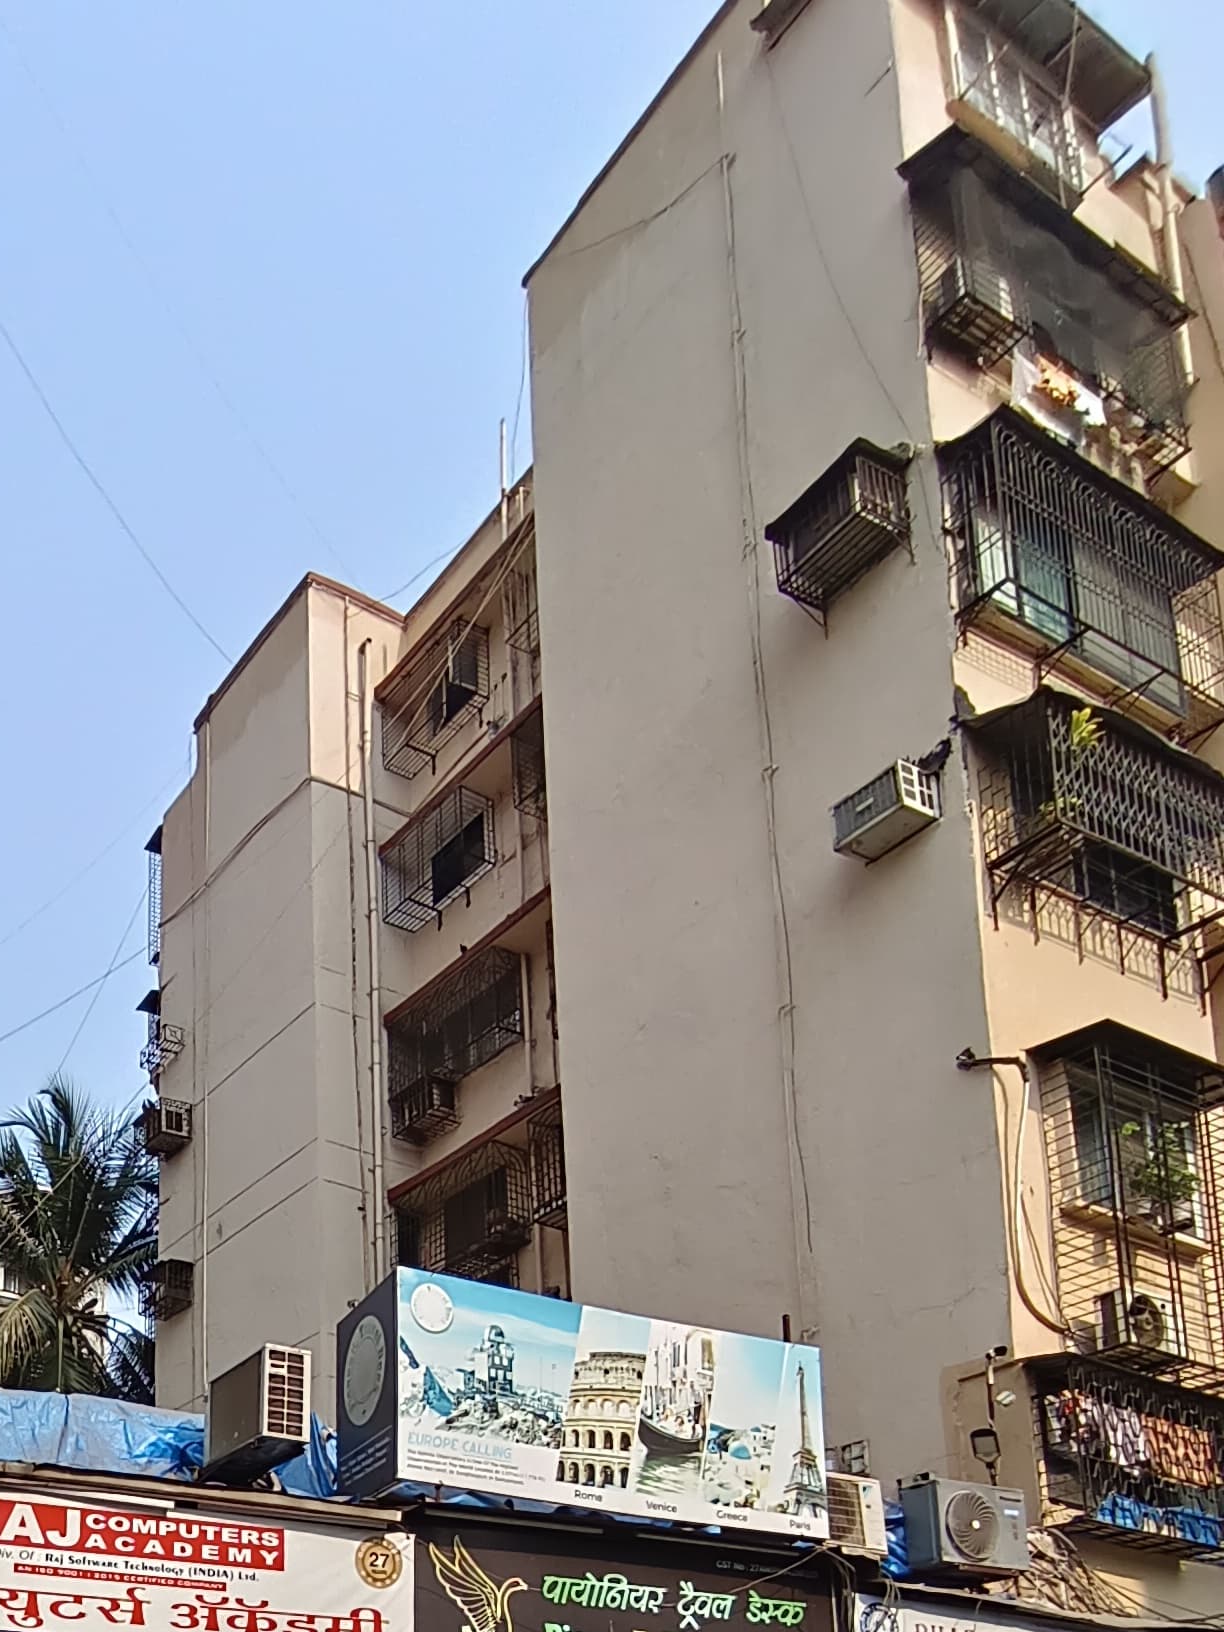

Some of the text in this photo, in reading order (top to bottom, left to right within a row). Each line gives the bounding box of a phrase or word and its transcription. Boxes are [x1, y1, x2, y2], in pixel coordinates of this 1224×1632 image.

[407, 1432, 459, 1450] EUROPE
[462, 1440, 513, 1460] CALLING
[574, 1489, 603, 1503] Rome
[645, 1500, 678, 1514] Venice
[715, 1509, 748, 1523] Greece
[789, 1518, 812, 1532] Paris
[84, 1513, 280, 1547] COMPUTERS
[84, 1533, 280, 1566] ACADEMY
[369, 1551, 390, 1569] 27
[18, 1549, 36, 1561] Of
[187, 1565, 235, 1582] (INDIA)
[237, 1570, 259, 1582] Ltd.
[34, 1566, 54, 1575] ISO
[123, 1575, 175, 1586] CERTIFIED
[176, 1579, 224, 1590] COMPANY
[541, 1571, 807, 1631] पायोनियर ट्रैवल डेस्क
